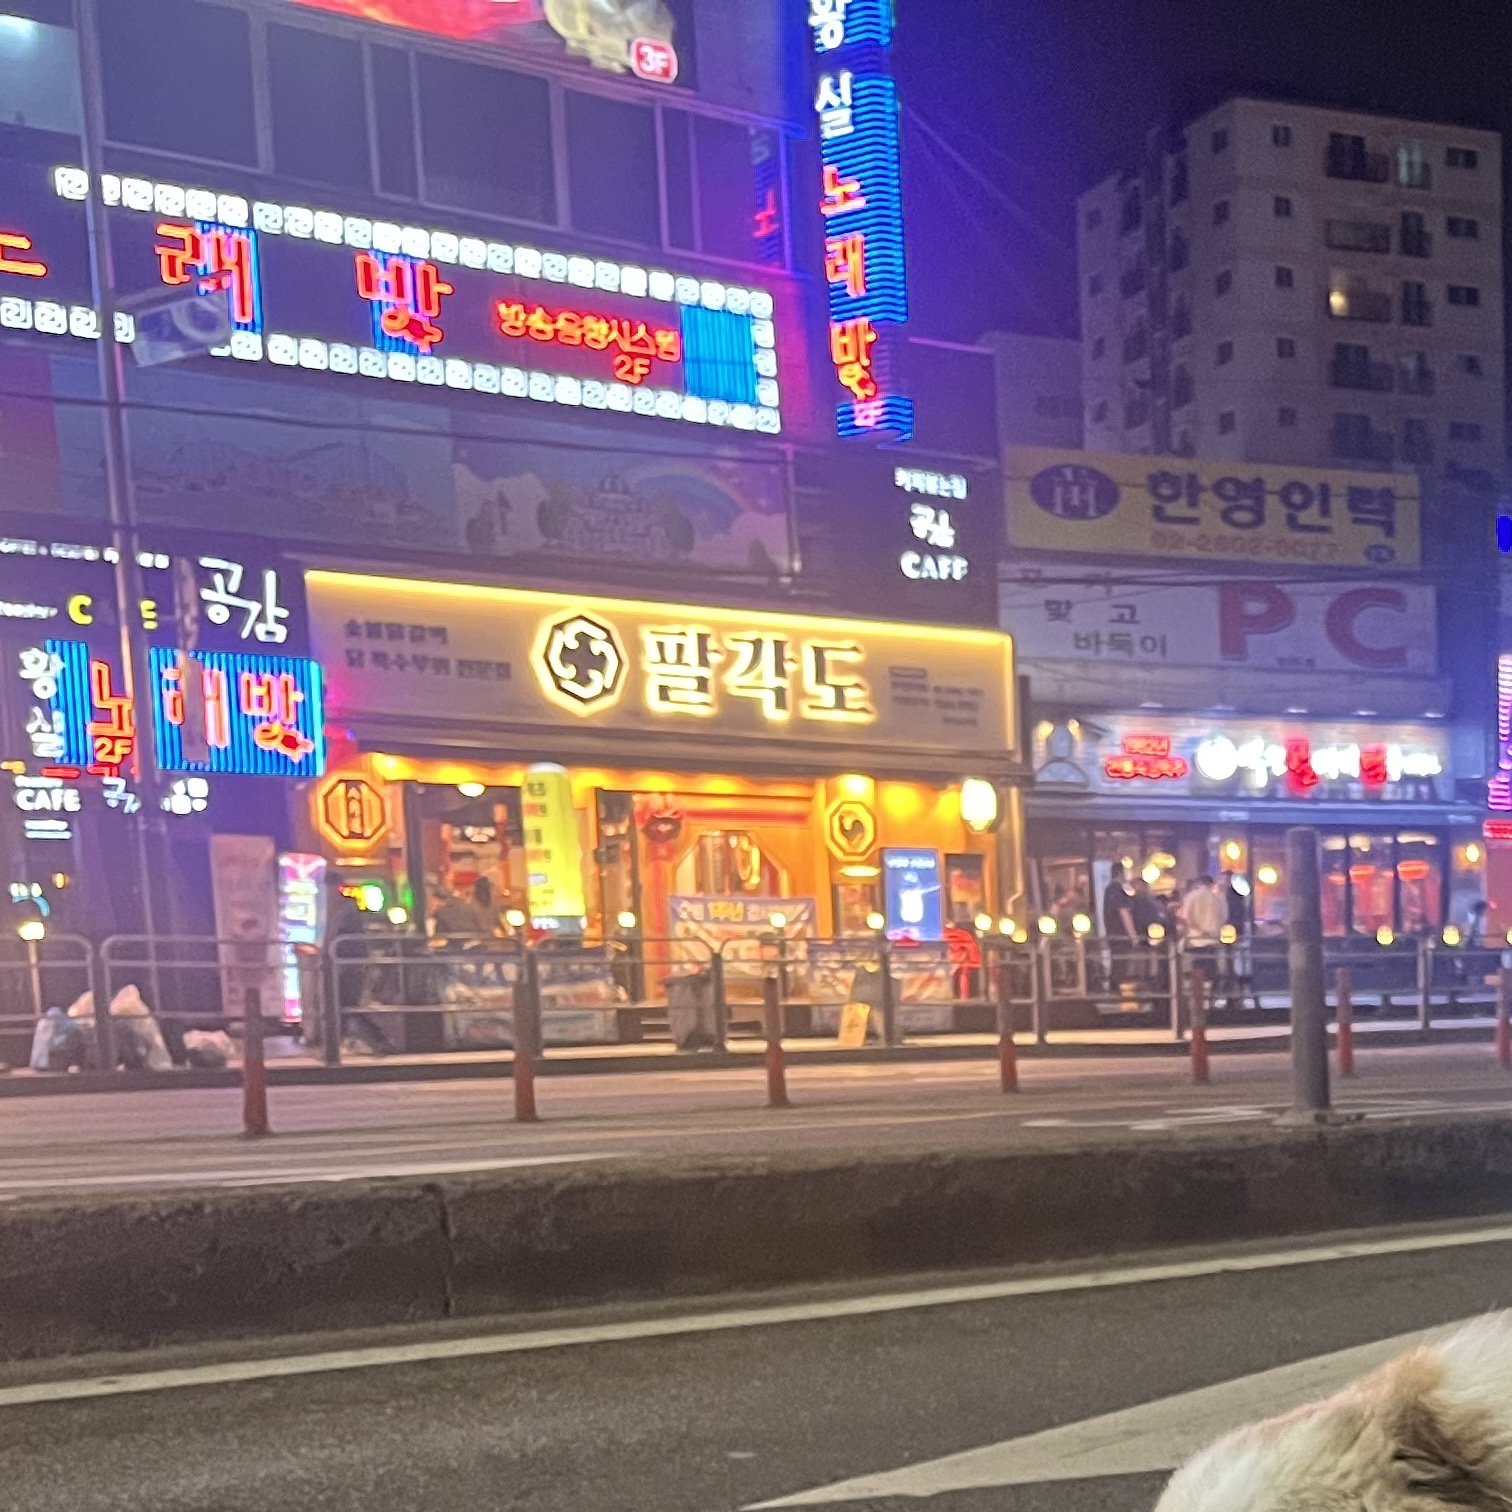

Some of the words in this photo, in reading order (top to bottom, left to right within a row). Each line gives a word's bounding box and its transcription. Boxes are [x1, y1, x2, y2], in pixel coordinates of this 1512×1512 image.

[820, 164, 878, 401] 노래방
[613, 354, 651, 385] 2F
[199, 556, 290, 644] 공감
[1218, 580, 1408, 669] PC
[641, 625, 875, 722] 팔각도
[95, 737, 132, 764] 2F
[14, 788, 81, 812] CAFE
